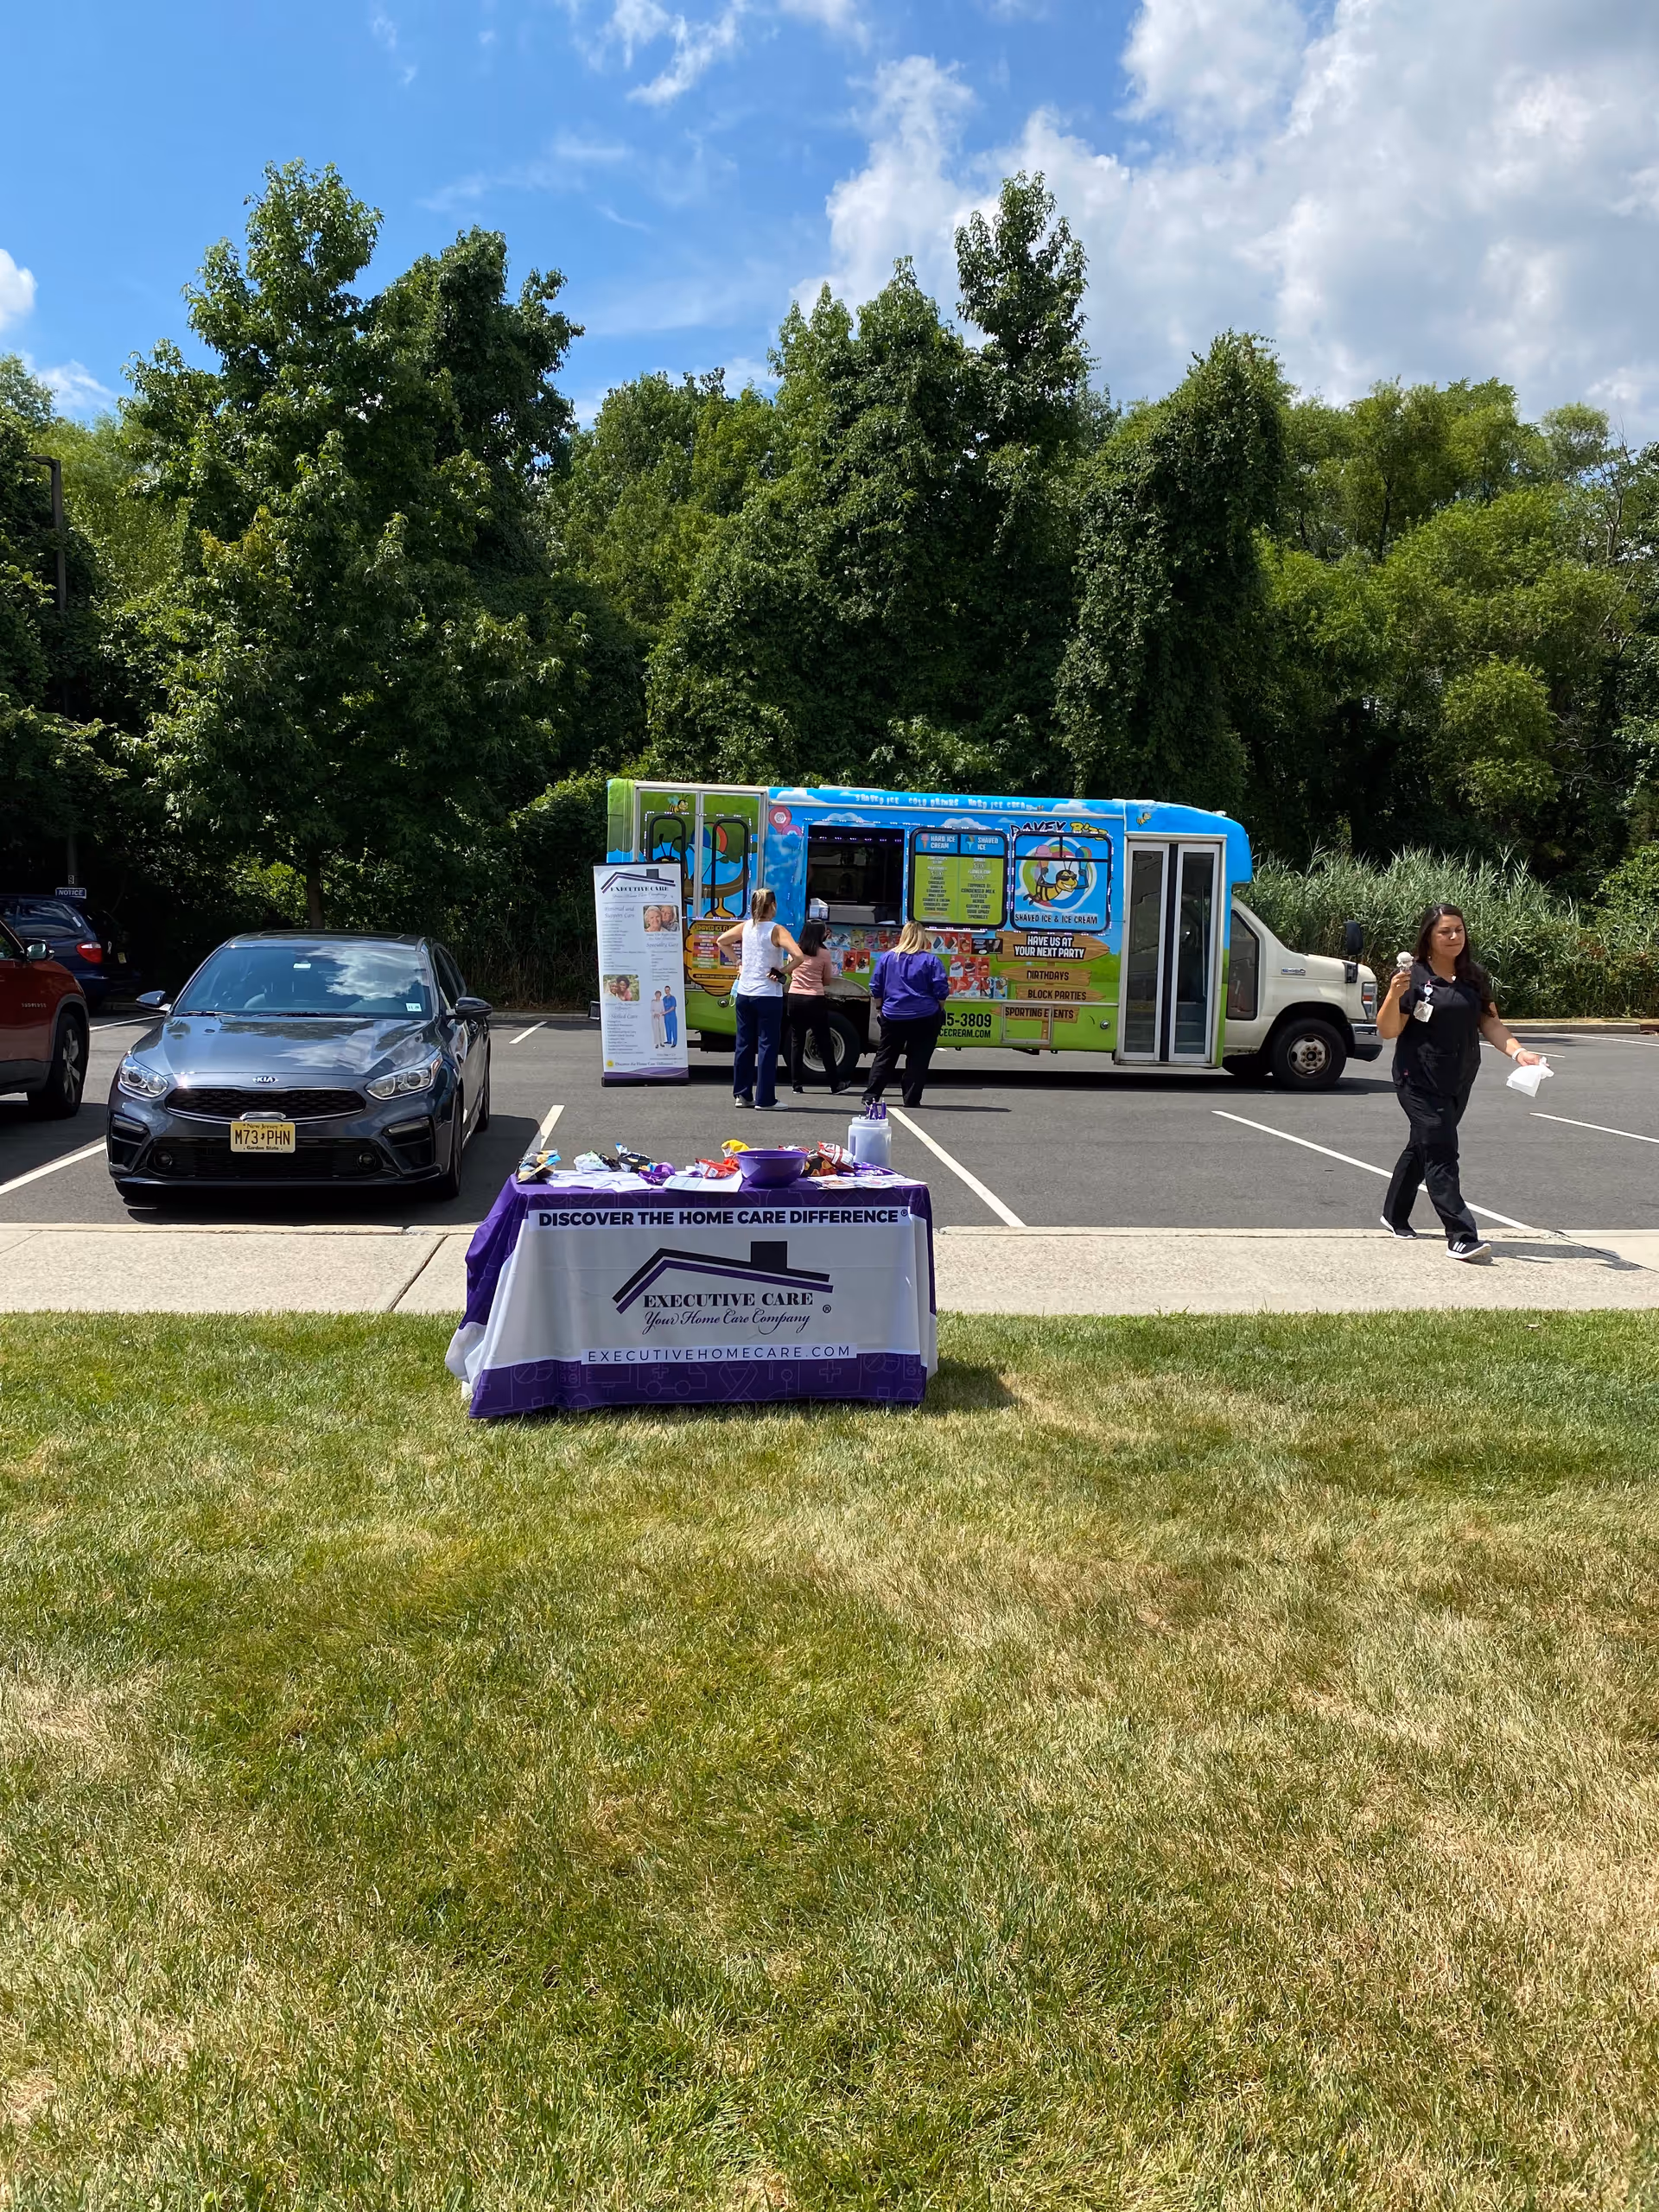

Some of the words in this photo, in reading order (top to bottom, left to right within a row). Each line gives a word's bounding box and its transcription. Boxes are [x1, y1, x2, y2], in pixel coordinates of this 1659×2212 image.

[908, 797, 926, 807] COLD
[931, 797, 959, 808] DRINKS
[1014, 913, 1039, 922] SHAVED
[1042, 914, 1052, 923] ICE
[1061, 914, 1071, 924] ICE
[1074, 915, 1097, 925] CREAM
[1027, 936, 1049, 946] HAVE
[1049, 936, 1060, 947] US
[1061, 937, 1072, 947] AT
[1014, 945, 1036, 957] YOUR
[1036, 946, 1057, 957] NEXT
[1058, 947, 1084, 958] PARTY
[1027, 989, 1052, 1000] BLOCK
[1054, 990, 1087, 1001] PARTIES
[944, 1012, 992, 1027] 5-3809
[1005, 1007, 1042, 1018] SPORTING
[1044, 1008, 1074, 1019] EENTS
[938, 1027, 991, 1039] CECREAM.COM
[235, 1129, 258, 1145] M73
[267, 1130, 290, 1145] PHN
[538, 1209, 634, 1227] DISCOVER
[638, 1209, 674, 1226] THE
[678, 1209, 734, 1225] HOME
[737, 1209, 786, 1225] CARE
[643, 1294, 755, 1308] EXECUTIVE
[761, 1293, 813, 1306] CARE
[641, 1310, 679, 1335] Your
[679, 1309, 721, 1325] Home
[722, 1308, 749, 1325] Care
[752, 1307, 810, 1335] Company
[588, 1345, 850, 1363] EXECUTIVEHOMECARE.COM
